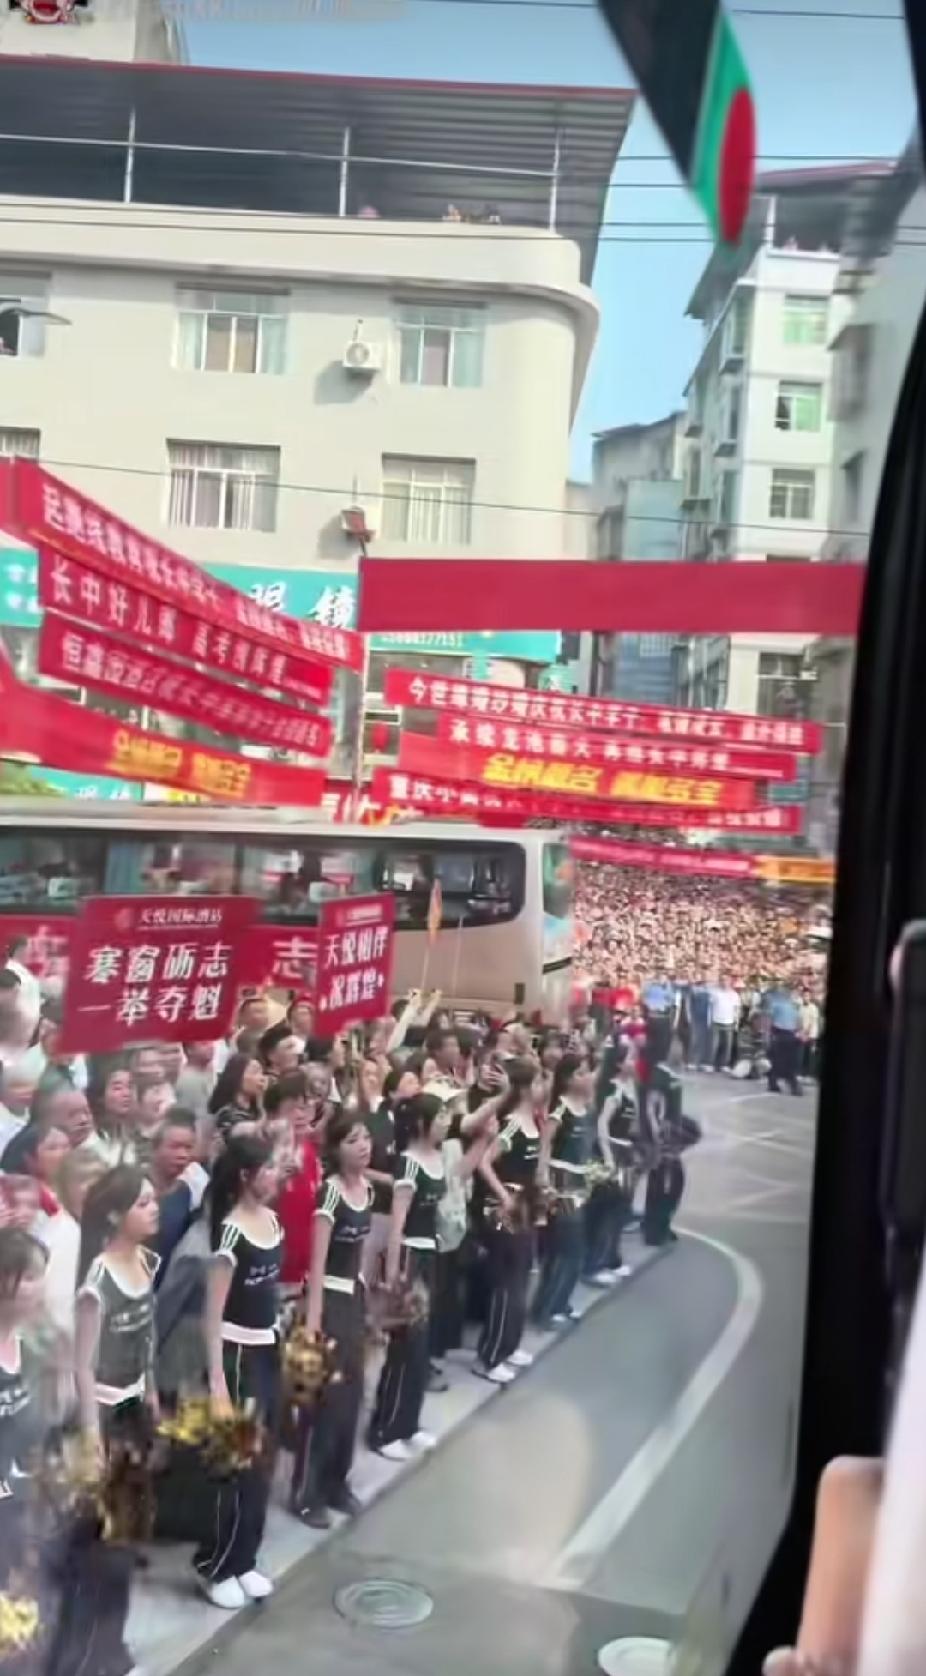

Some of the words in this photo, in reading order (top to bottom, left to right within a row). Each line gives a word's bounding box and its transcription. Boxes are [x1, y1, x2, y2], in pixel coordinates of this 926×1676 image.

[82, 941, 233, 985] 寒窗砺志
[78, 984, 222, 1026] 一举夺魁
